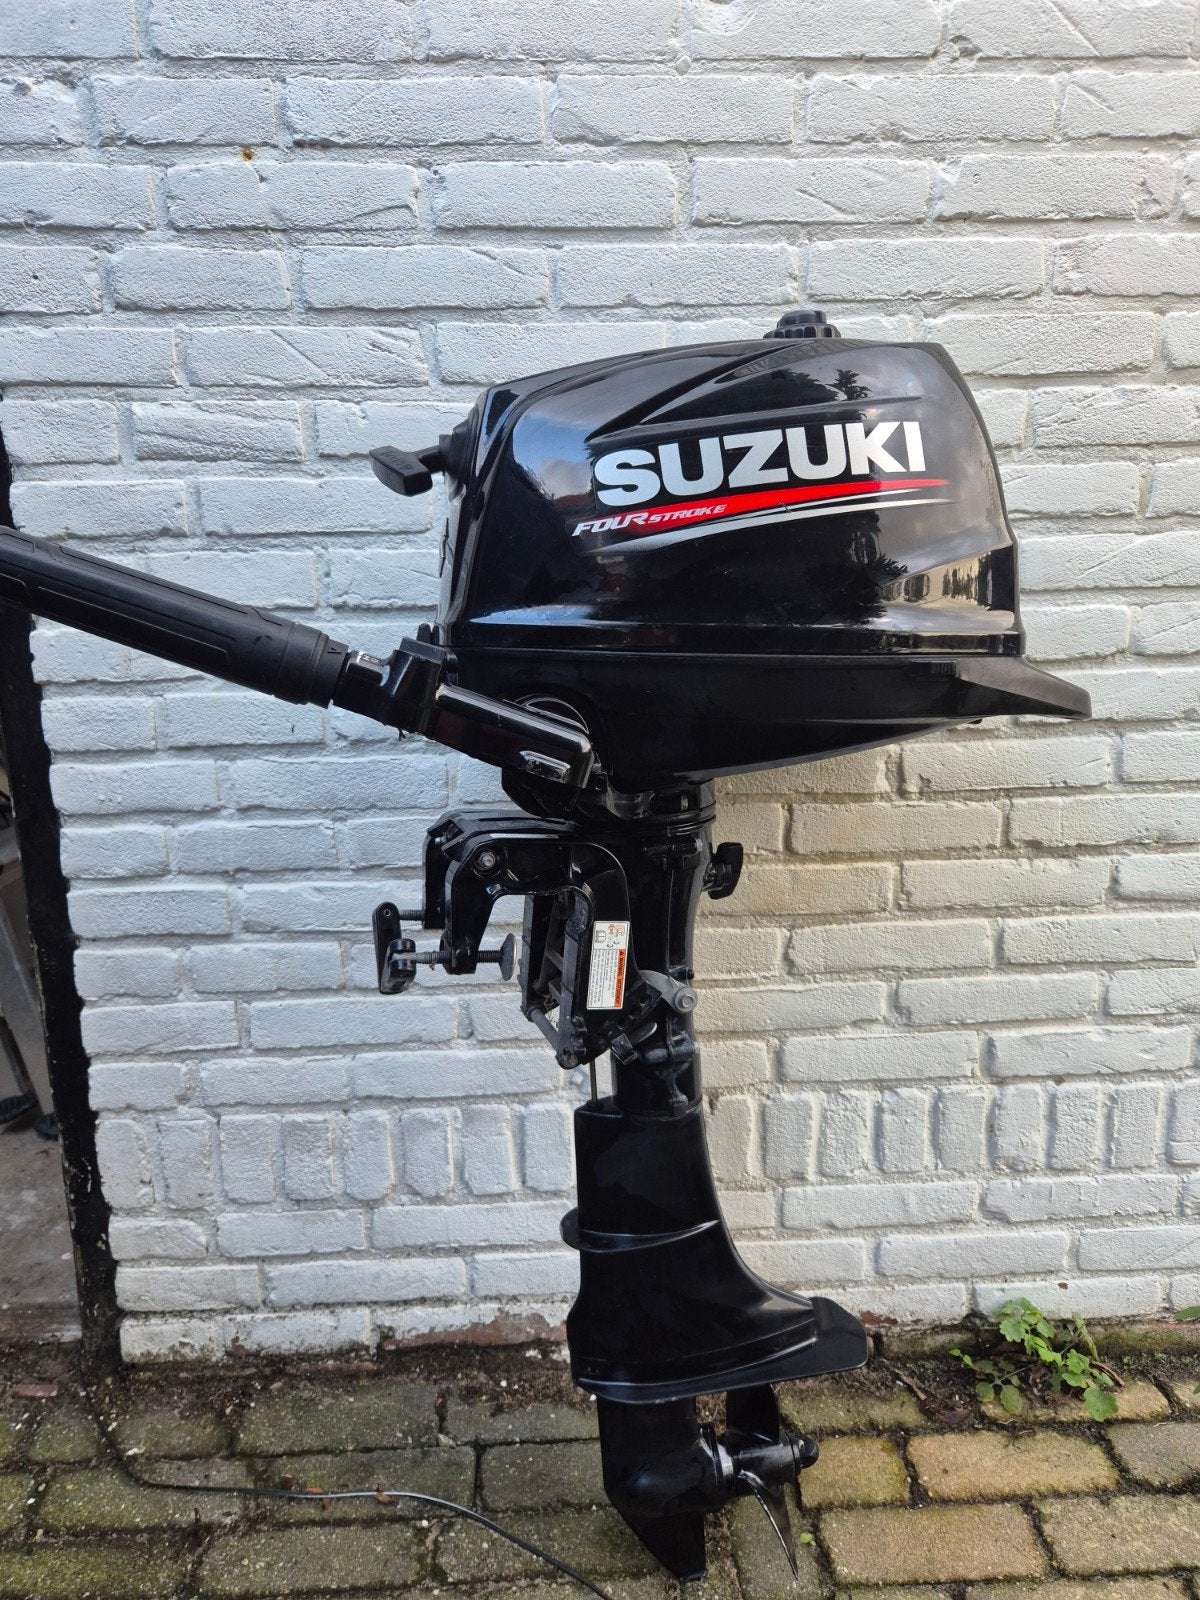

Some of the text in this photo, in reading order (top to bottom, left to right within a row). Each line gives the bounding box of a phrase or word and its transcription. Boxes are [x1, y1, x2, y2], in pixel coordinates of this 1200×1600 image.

[594, 421, 926, 507] SUZUKI
[572, 503, 727, 536] FOUR STROKE
